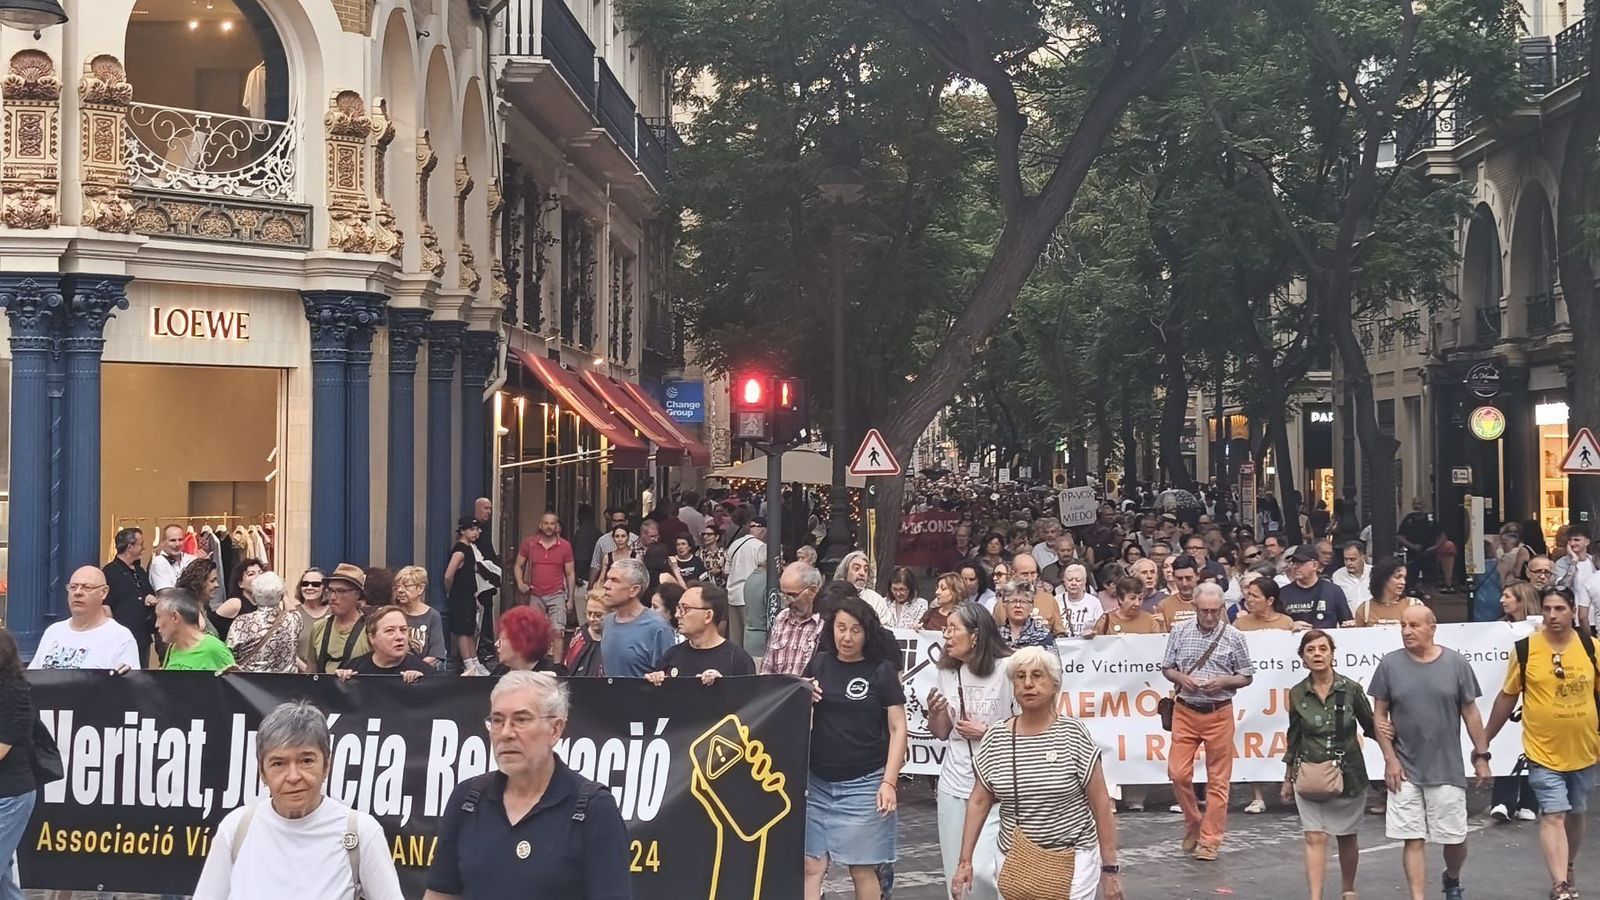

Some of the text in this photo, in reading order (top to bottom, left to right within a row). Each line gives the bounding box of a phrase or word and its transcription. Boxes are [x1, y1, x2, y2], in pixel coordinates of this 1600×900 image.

[153, 307, 250, 340] LOEWE
[666, 400, 701, 410] Change
[666, 408, 694, 418] Group
[1063, 510, 1093, 522] MIEDO
[1065, 659, 1085, 673] de
[1346, 653, 1385, 667] DAN
[1118, 734, 1126, 761] I
[39, 709, 214, 820] Veritat,
[424, 717, 670, 822] Reació
[36, 821, 175, 856] Associació
